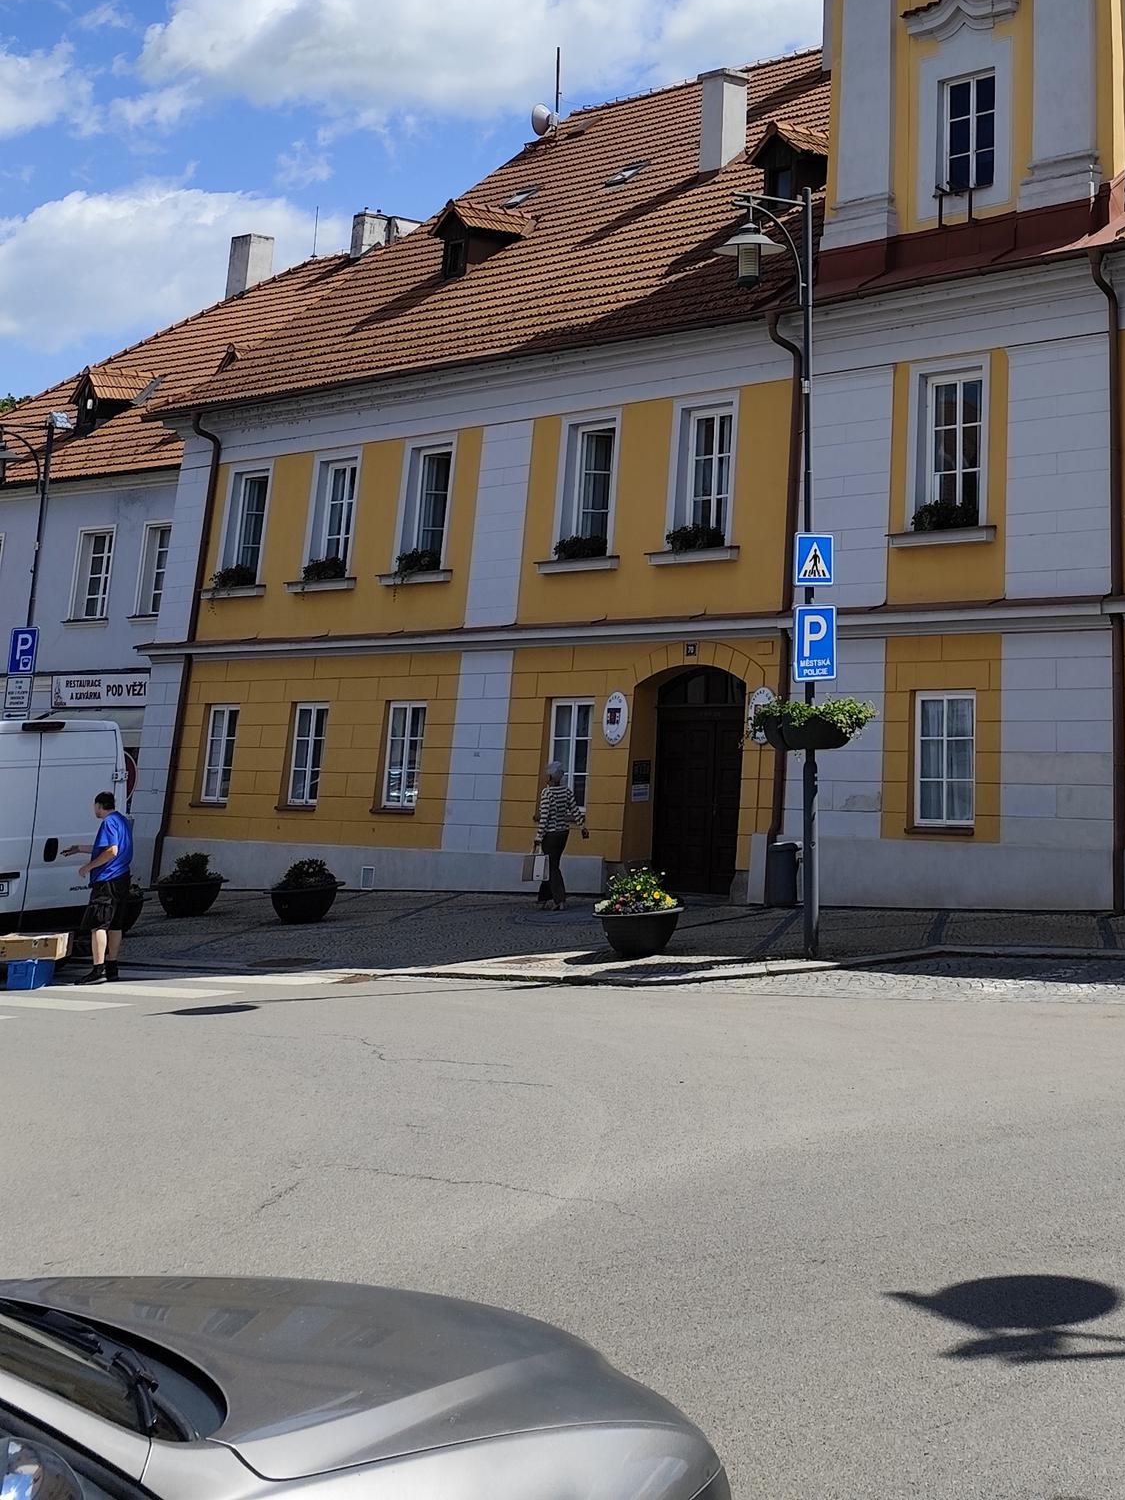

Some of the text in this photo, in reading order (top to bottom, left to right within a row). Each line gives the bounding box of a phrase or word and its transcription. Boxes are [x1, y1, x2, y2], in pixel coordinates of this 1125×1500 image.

[803, 614, 828, 657] P
[16, 633, 32, 660] P
[800, 657, 831, 667] MĚSTSKÁ
[803, 667, 828, 676] POLICIE
[65, 678, 102, 688] RESTAURACE
[106, 680, 148, 697] POD VĚŽÍ
[75, 690, 102, 701] KAVÁRNA
